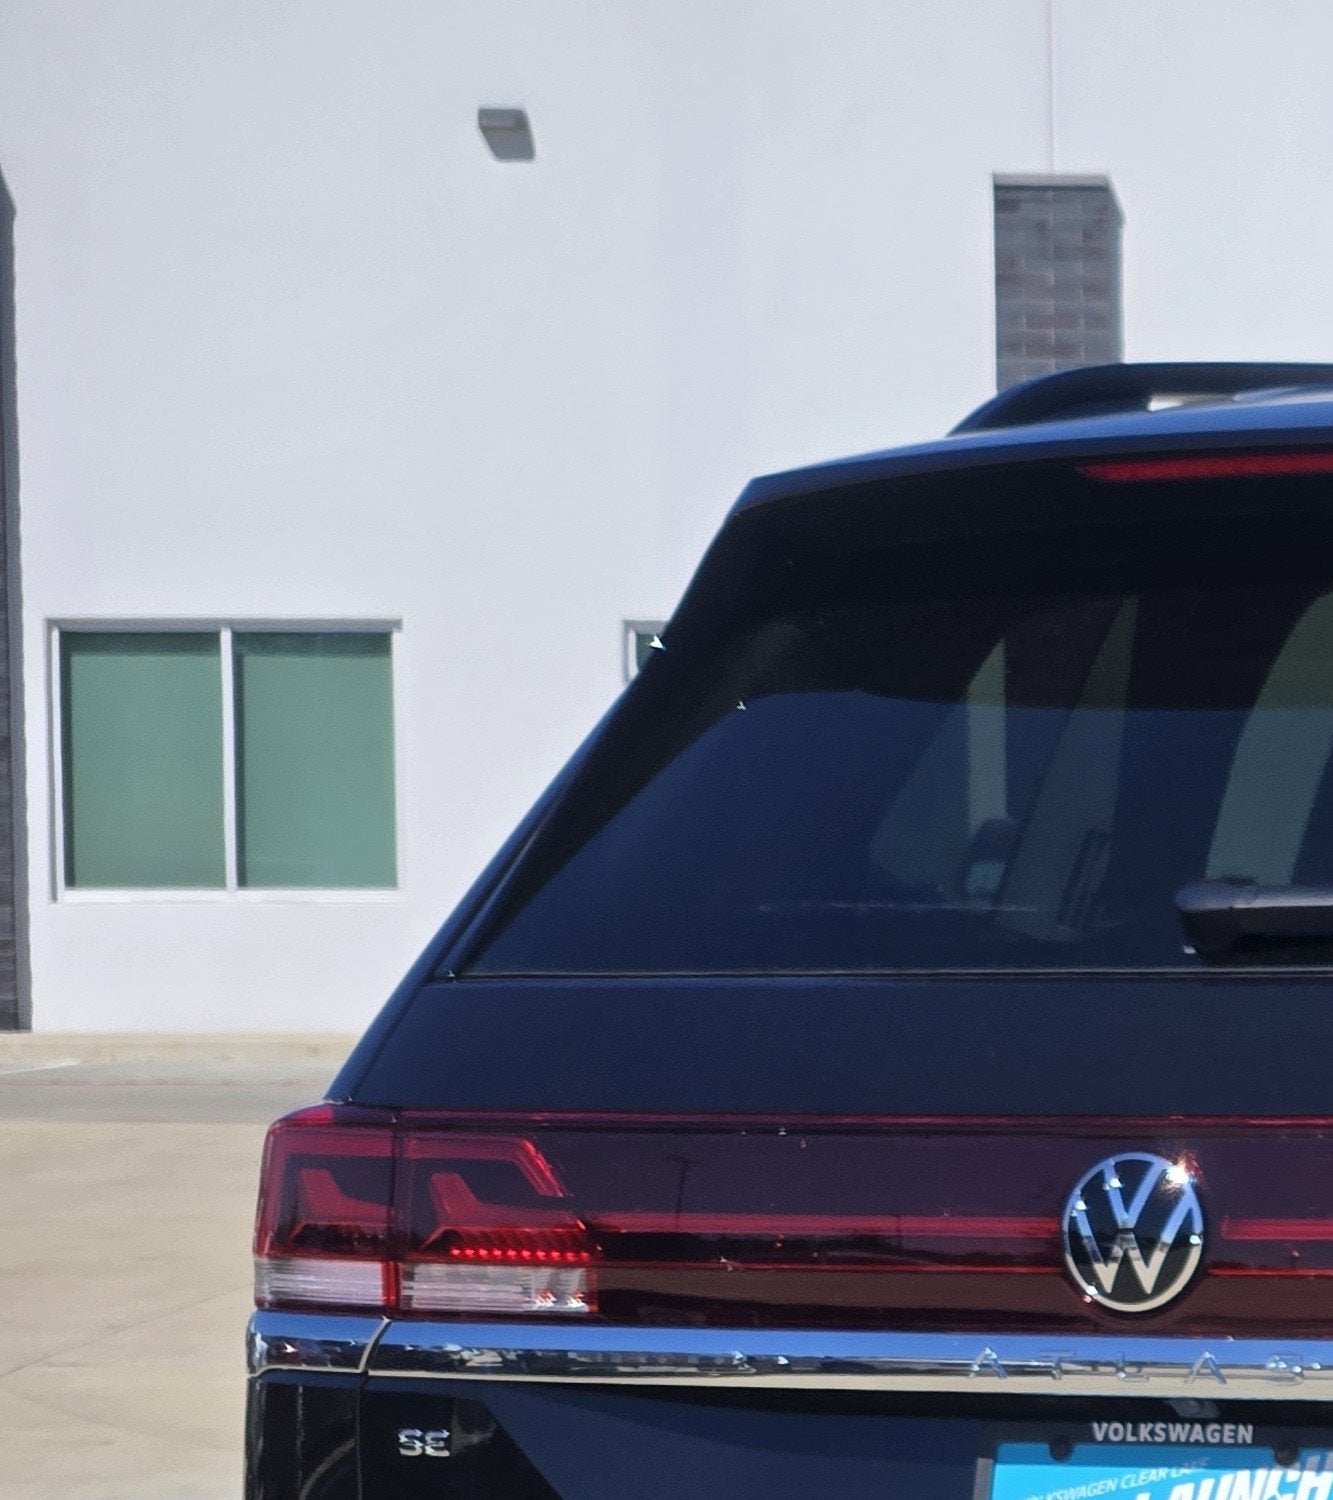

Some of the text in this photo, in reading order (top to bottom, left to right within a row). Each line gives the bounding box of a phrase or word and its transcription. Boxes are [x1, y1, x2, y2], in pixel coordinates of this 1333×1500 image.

[1063, 1152, 1203, 1312] VW
[398, 1428, 450, 1457] SE
[1092, 1421, 1253, 1444] VOLKSWAGEN
[1120, 1467, 1169, 1490] CLEAR
